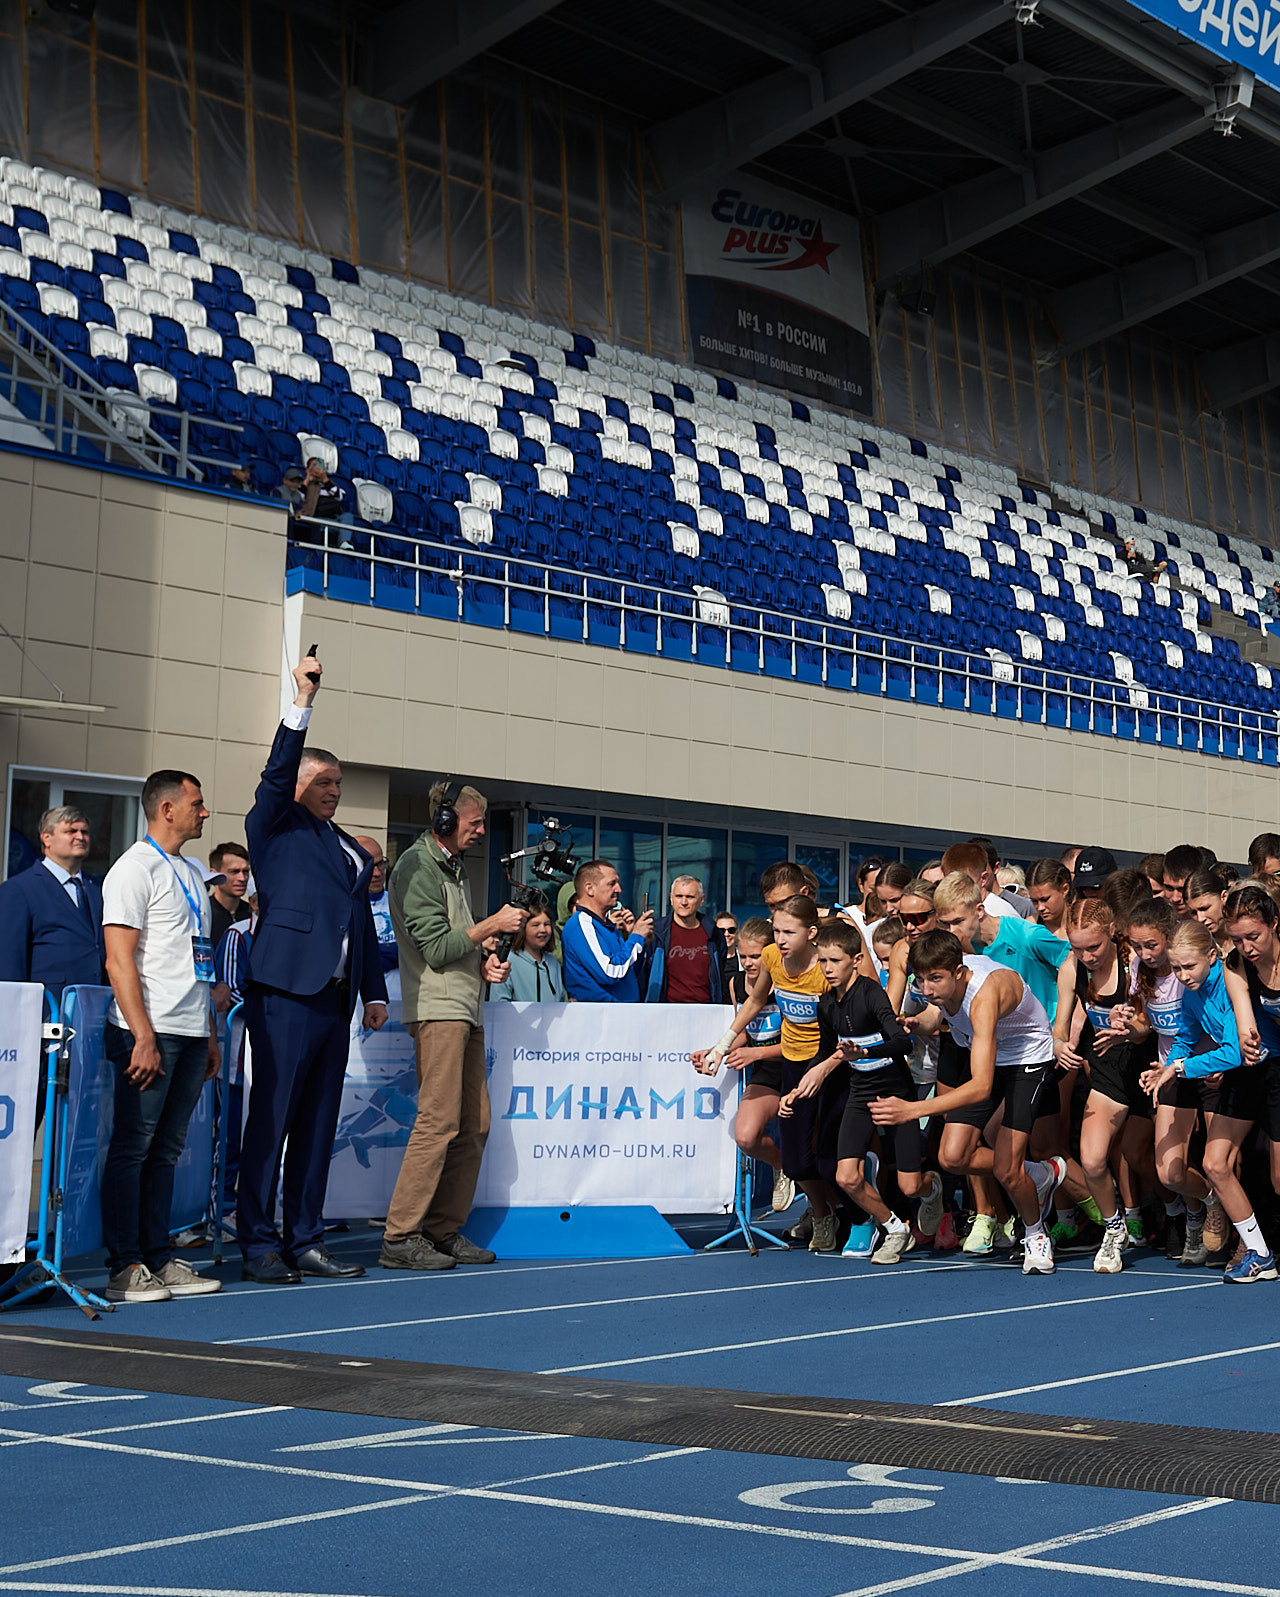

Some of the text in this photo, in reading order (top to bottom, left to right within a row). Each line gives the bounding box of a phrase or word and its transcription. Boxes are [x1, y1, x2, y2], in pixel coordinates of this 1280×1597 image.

[737, 309, 761, 333] №1
[777, 322, 827, 355] РОССИИ
[700, 335, 738, 358] БОЛЬШЕ
[738, 345, 768, 366] ХИТОВ!
[769, 356, 804, 378] БОЛЬШЕ
[782, 1000, 814, 1016] 1688
[513, 1048, 580, 1064] История
[585, 1050, 642, 1064] страны
[658, 1051, 692, 1063] исто
[501, 1083, 723, 1121] ДИНАМО
[533, 1144, 696, 1159] DYNAMO-UDM.RU
